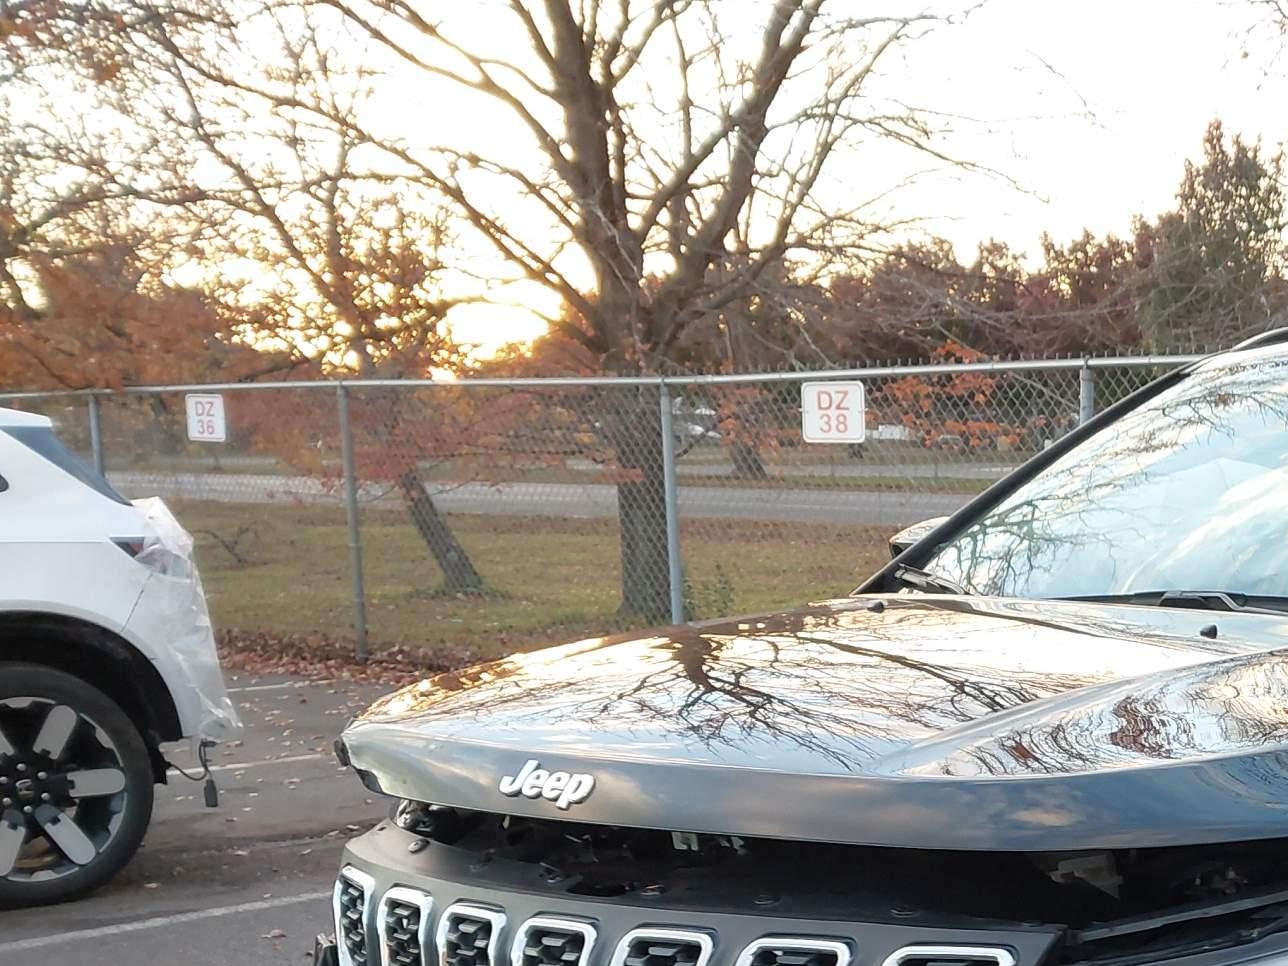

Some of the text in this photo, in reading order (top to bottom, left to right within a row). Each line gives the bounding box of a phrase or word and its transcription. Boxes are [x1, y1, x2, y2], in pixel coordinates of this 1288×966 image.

[194, 401, 215, 417] DZ
[817, 390, 849, 411] DZ
[197, 419, 215, 435] 36
[819, 413, 848, 433] 38
[499, 759, 595, 810] Jeep
